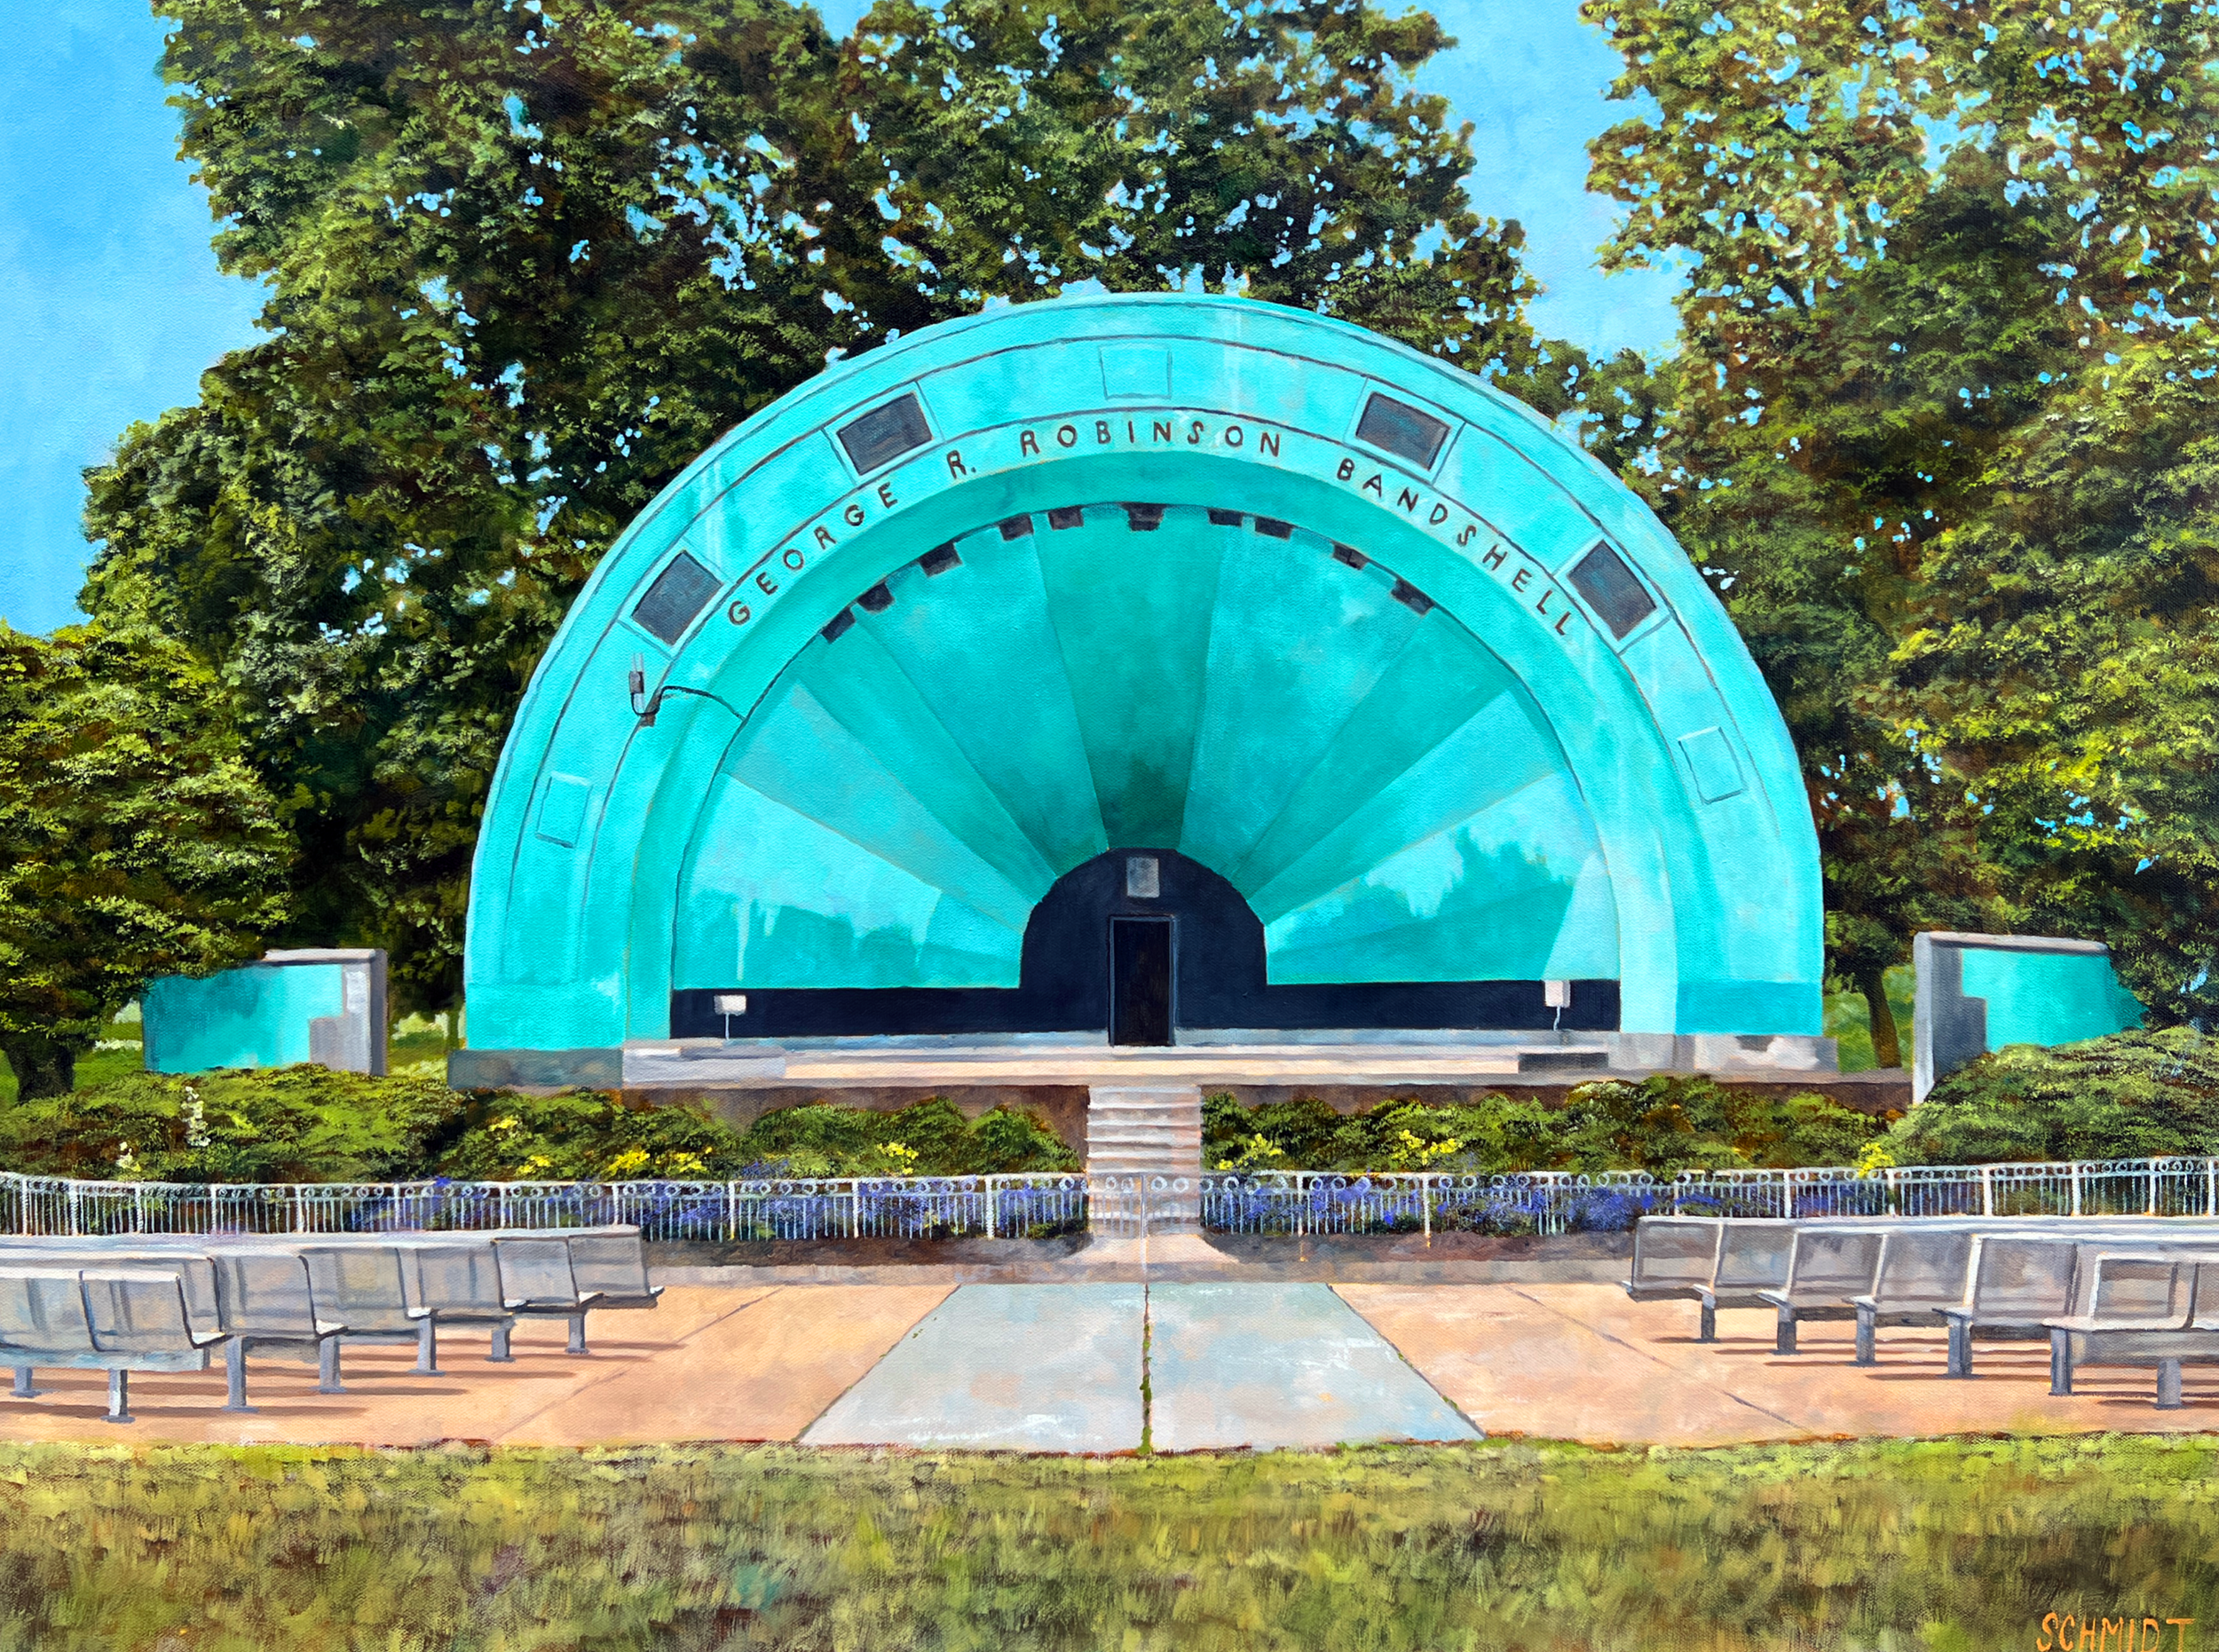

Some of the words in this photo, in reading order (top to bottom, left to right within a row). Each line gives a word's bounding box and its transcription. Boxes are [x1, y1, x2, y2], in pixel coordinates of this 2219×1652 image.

[728, 482, 898, 627] GEORGE
[947, 449, 977, 478] R.
[1020, 421, 1281, 457] ROBINSON
[1336, 458, 1572, 636] BANDSHELL
[2036, 1612, 2196, 1652] SCHMIDT
